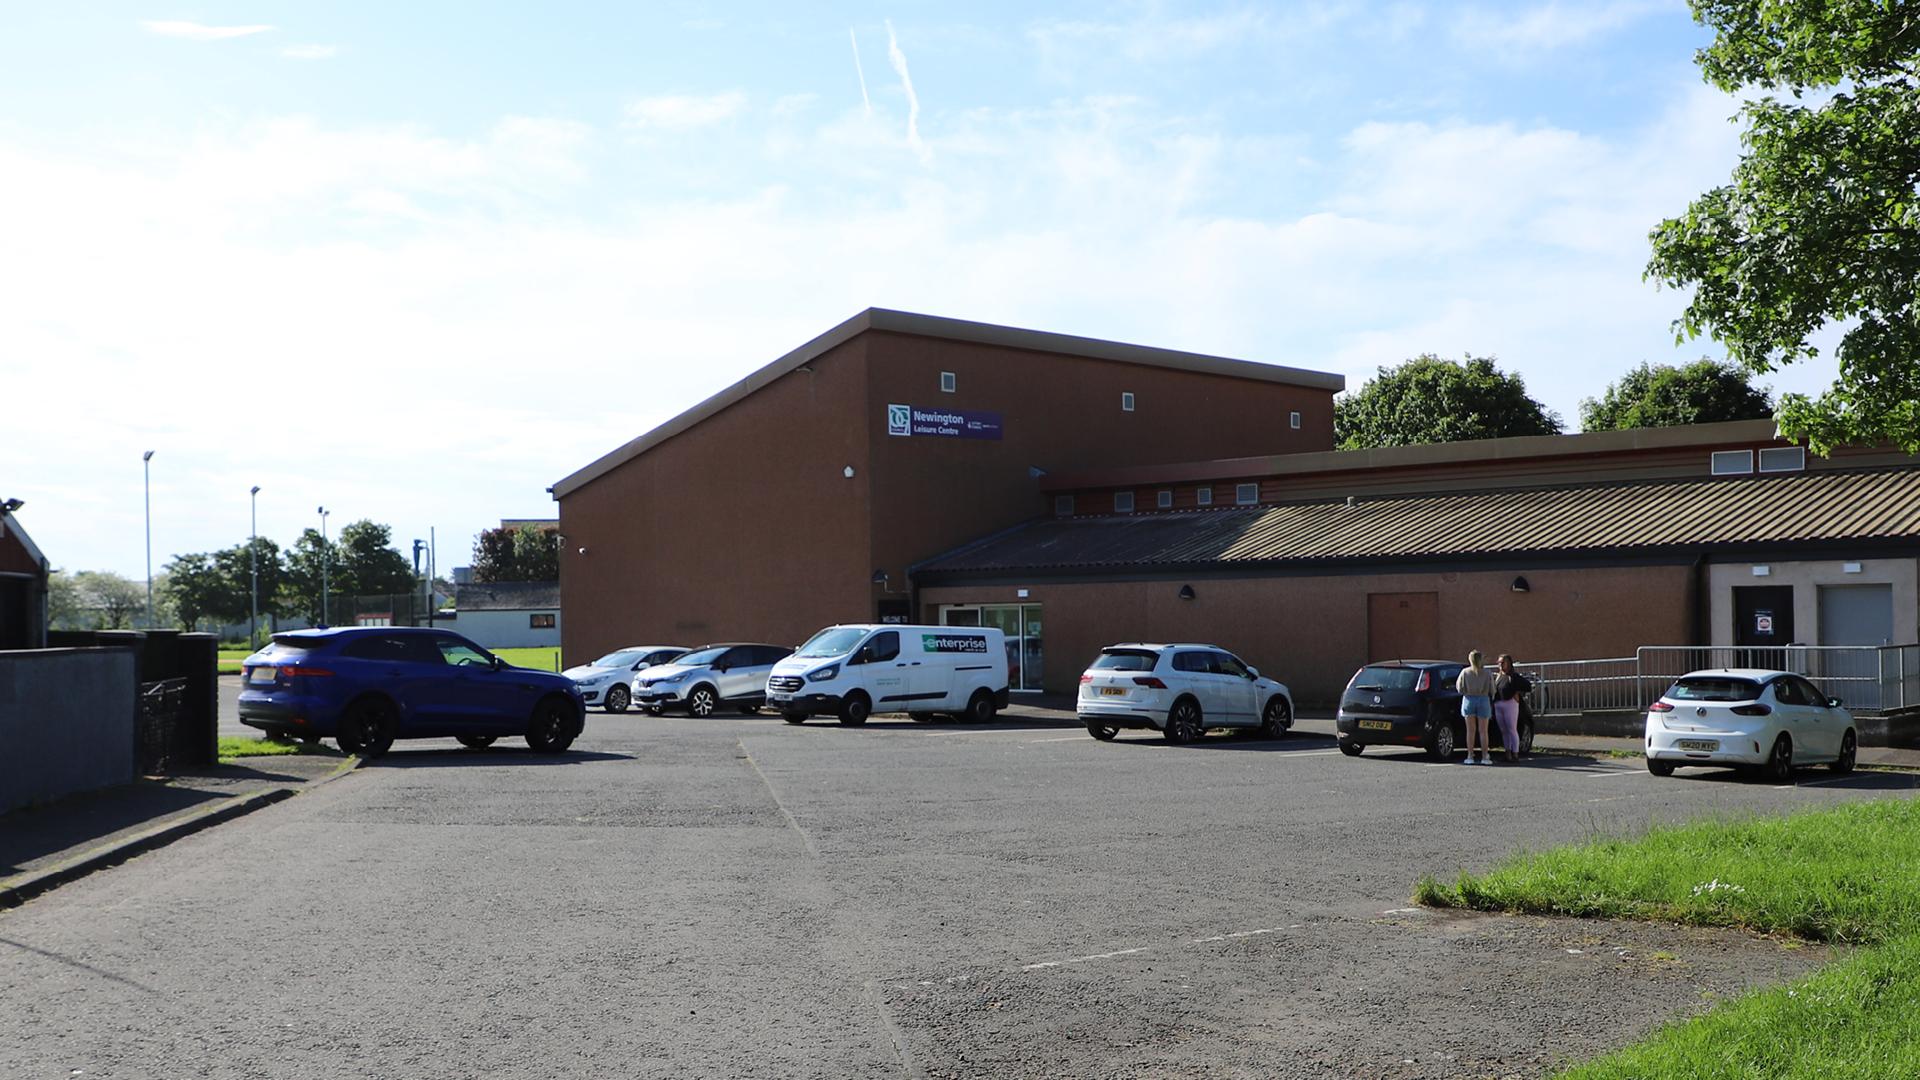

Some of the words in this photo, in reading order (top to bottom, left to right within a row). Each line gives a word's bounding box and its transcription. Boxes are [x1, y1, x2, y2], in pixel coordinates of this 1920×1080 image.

[914, 411, 964, 425] Newington
[914, 425, 937, 434] Leisure
[938, 426, 959, 435] Centre
[924, 638, 986, 650] enterprise
